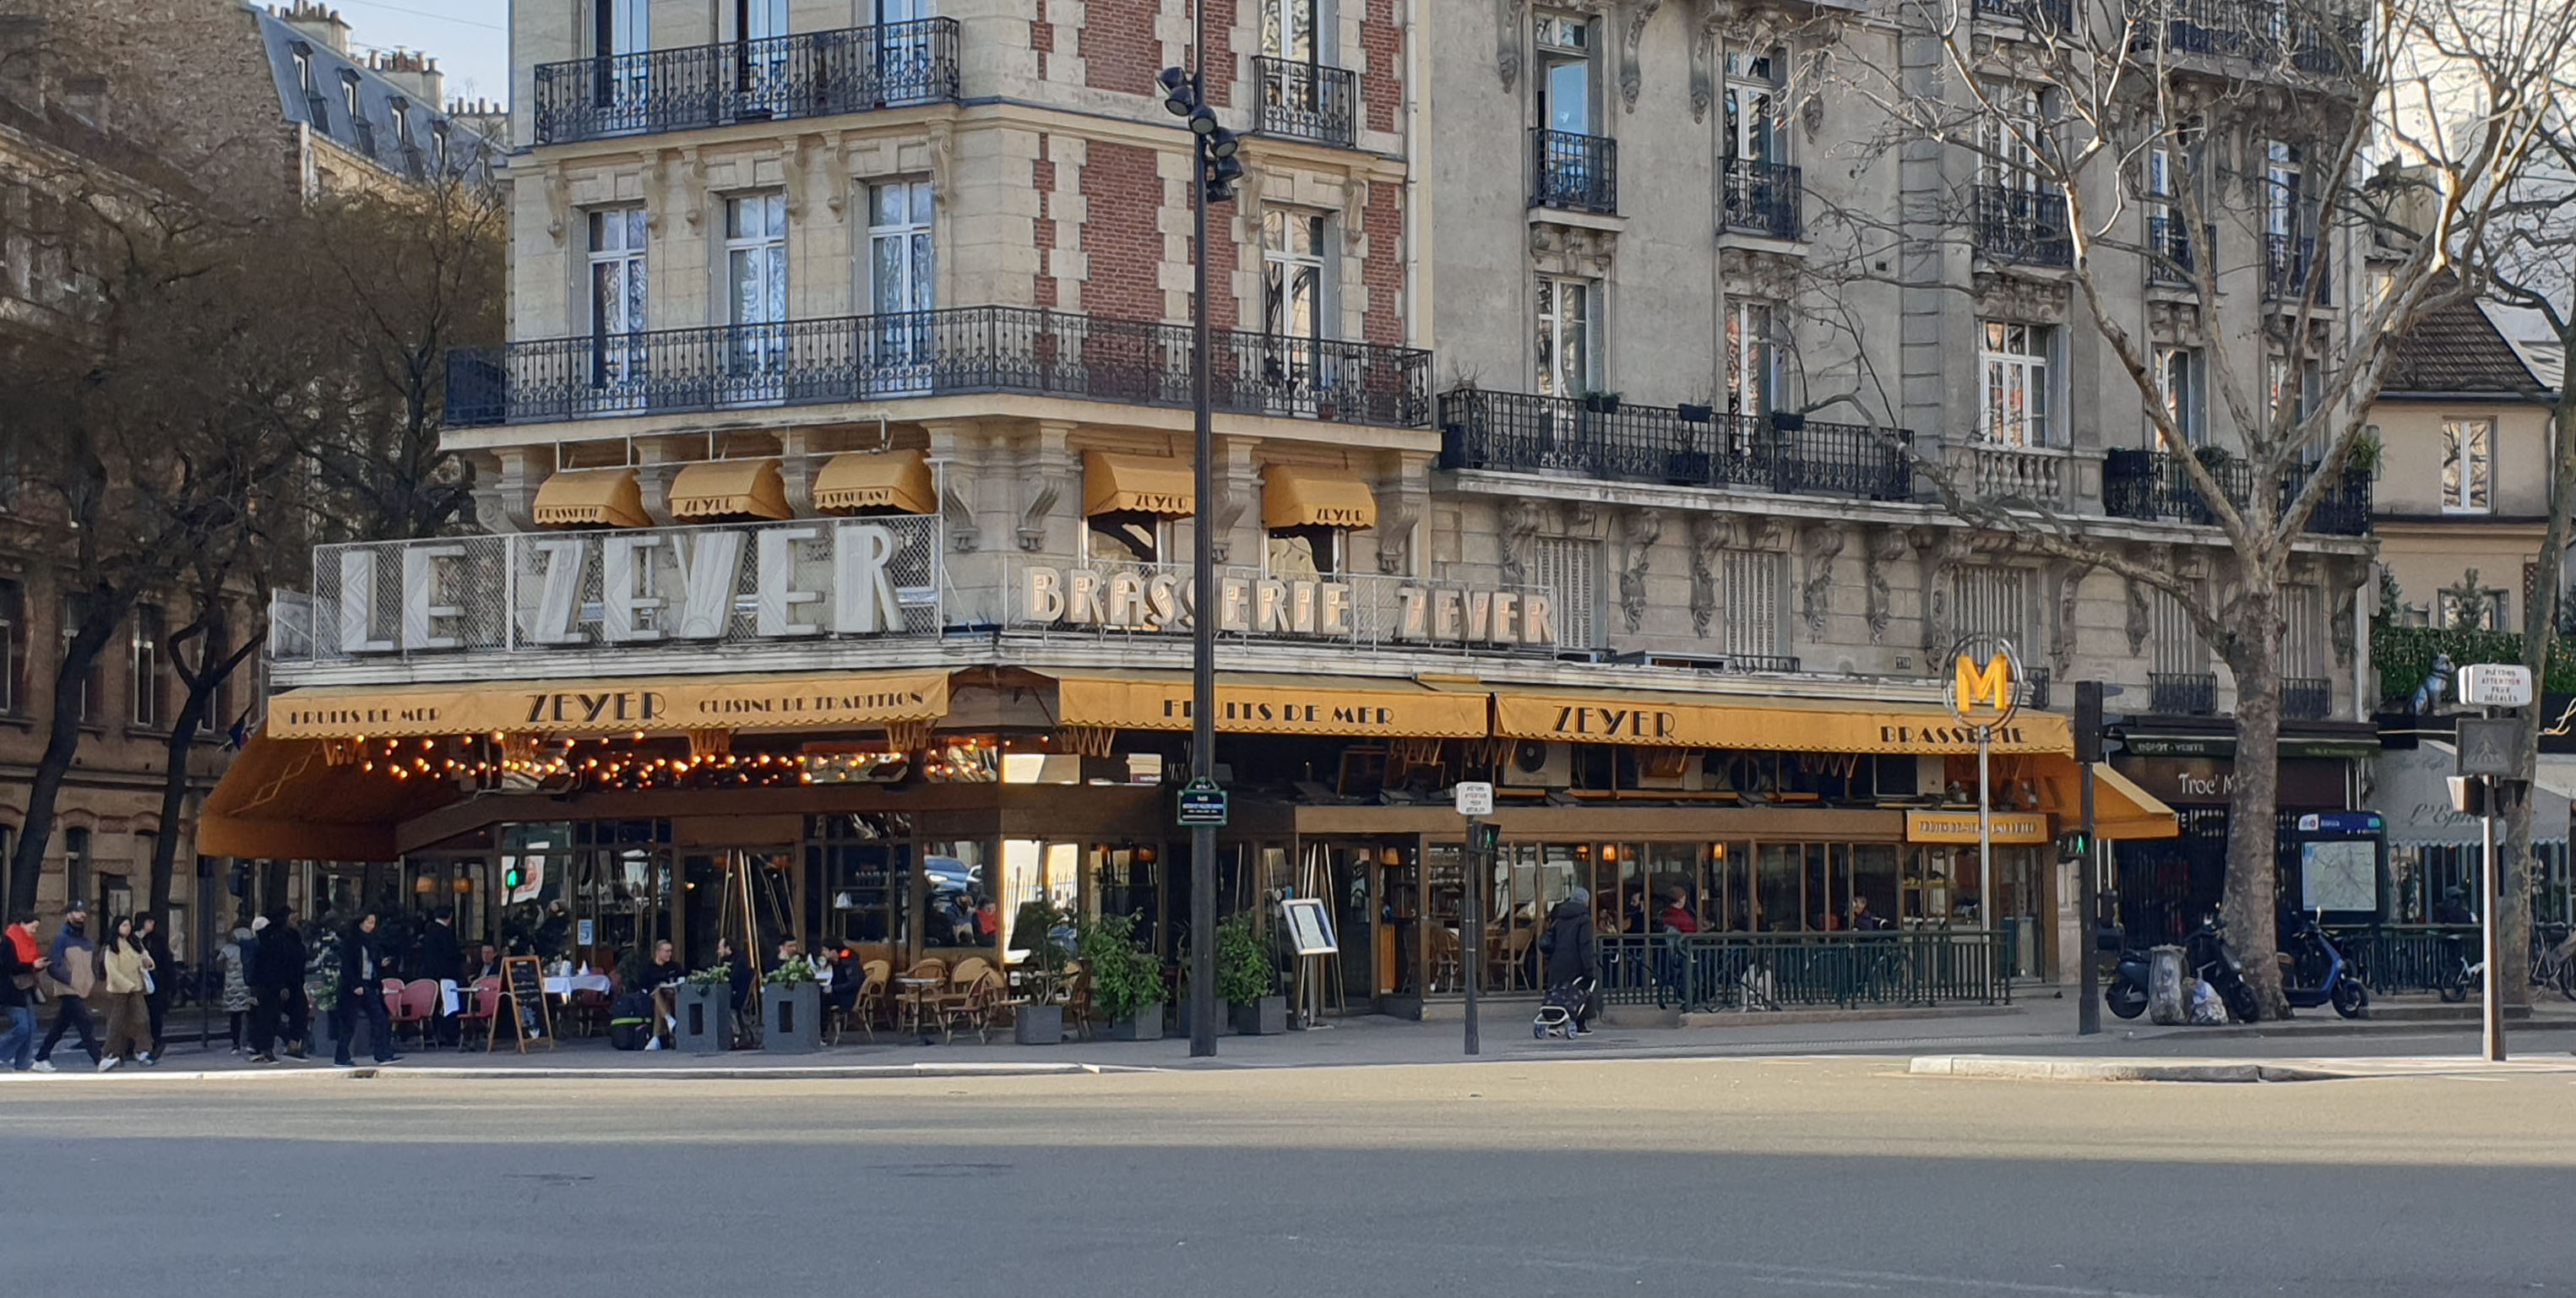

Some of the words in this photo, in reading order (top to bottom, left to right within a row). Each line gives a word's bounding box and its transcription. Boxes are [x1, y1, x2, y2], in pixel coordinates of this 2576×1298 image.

[682, 498, 733, 513] ZEYER
[1135, 494, 1187, 508] ZEYER
[1316, 508, 1365, 522] ZEYER
[340, 545, 465, 653] LE
[1956, 653, 2007, 713] M
[525, 692, 666, 723] ZEYER
[698, 698, 774, 714] CUISINE
[782, 697, 807, 712] DE
[813, 691, 925, 710] TRADITION
[291, 709, 361, 725] FRUITS
[367, 709, 392, 723] DE
[400, 707, 442, 722] MER
[1284, 703, 1320, 722] DE
[1331, 705, 1394, 725] MER
[1552, 705, 1676, 739] ZEYER
